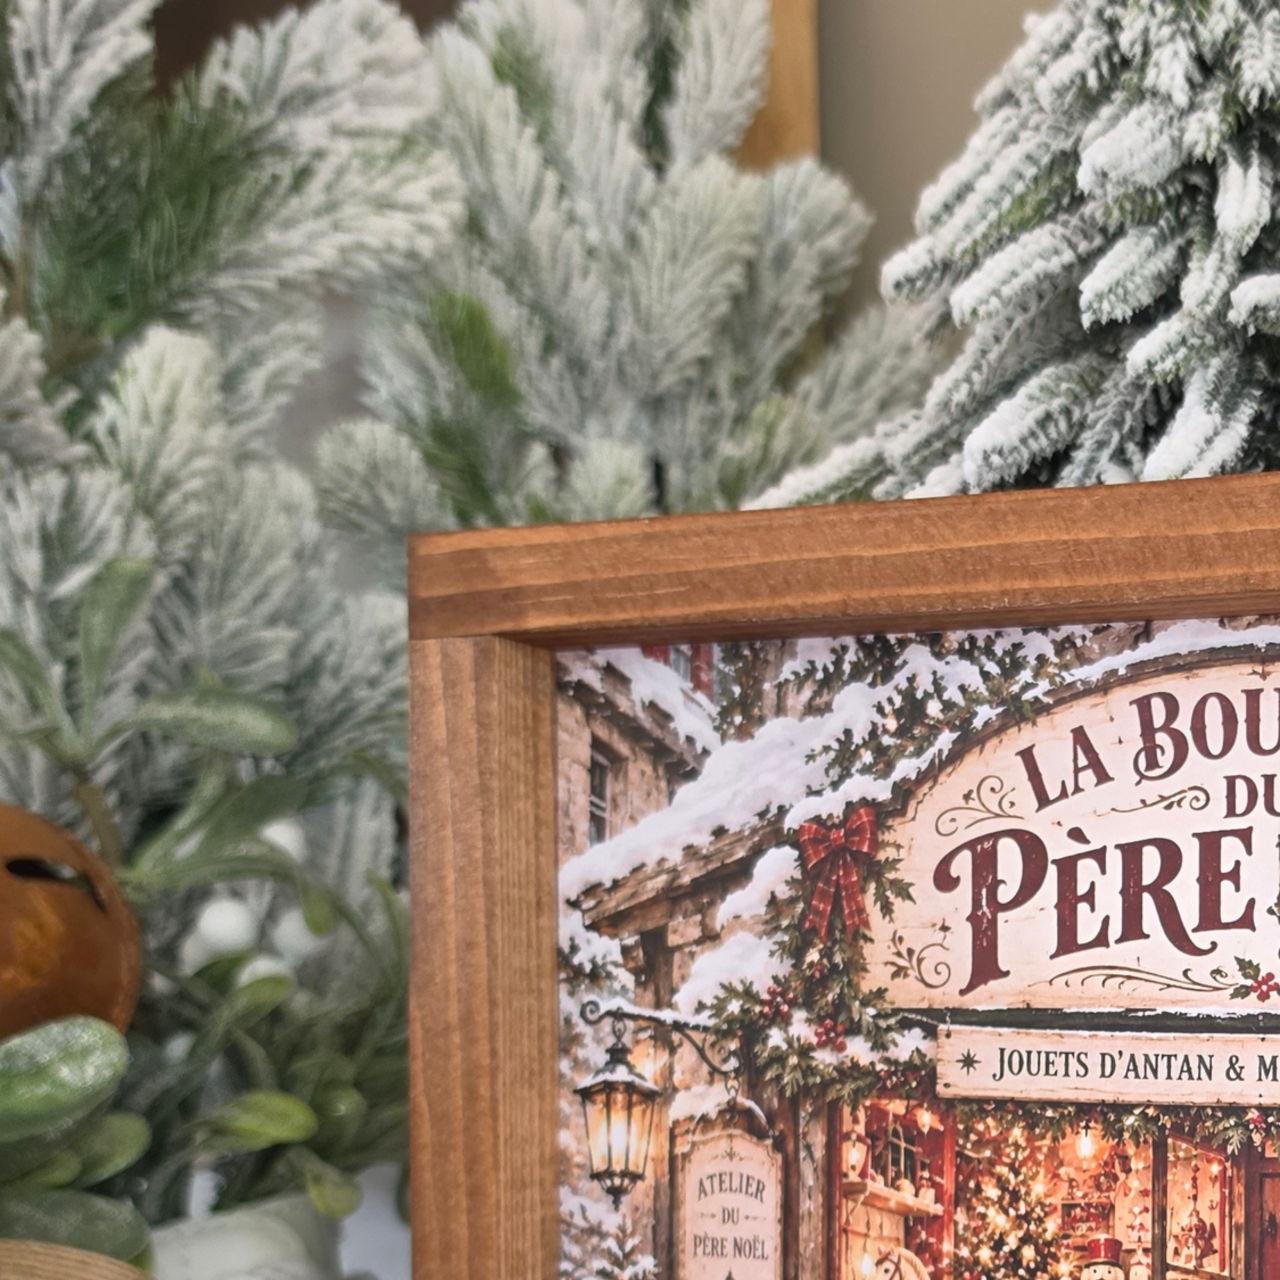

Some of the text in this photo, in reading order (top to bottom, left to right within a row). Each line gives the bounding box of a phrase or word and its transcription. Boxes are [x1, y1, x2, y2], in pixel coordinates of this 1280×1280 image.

[1015, 724, 1111, 812] LA
[932, 819, 1257, 996] PÈRE
[992, 1046, 1090, 1083] JOUETS
[1099, 1050, 1216, 1083] D'ANTAN
[1225, 1054, 1245, 1082] &
[698, 1171, 766, 1202] ATELIER
[721, 1207, 740, 1225] DU
[692, 1231, 769, 1261] PÈRE NOËL
